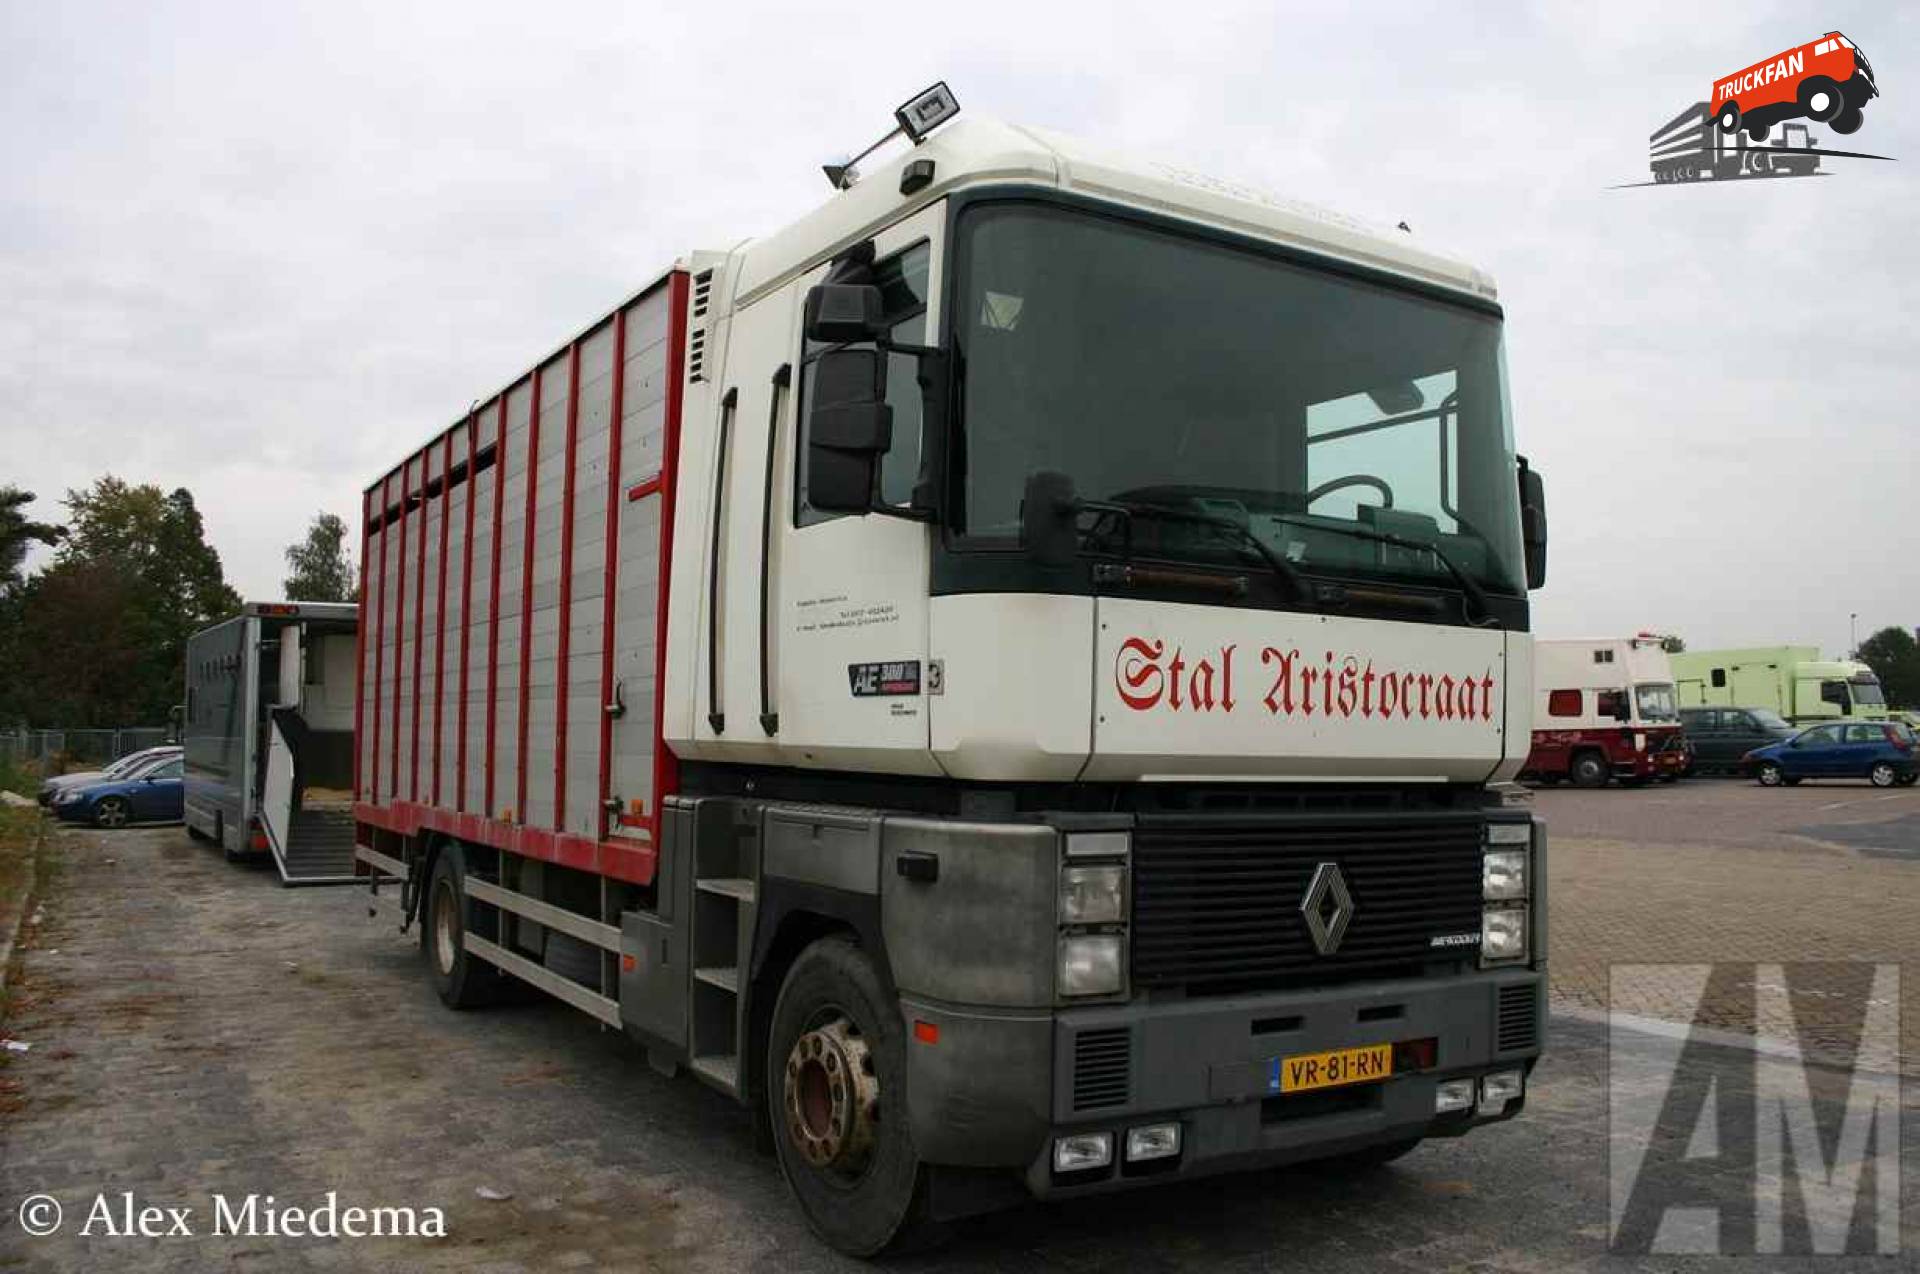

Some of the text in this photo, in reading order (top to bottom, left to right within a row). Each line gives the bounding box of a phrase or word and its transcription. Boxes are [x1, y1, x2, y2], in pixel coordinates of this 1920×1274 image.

[1115, 637, 1496, 722] Stal Aristocraat
[1289, 1049, 1386, 1085] VR-81-RN
